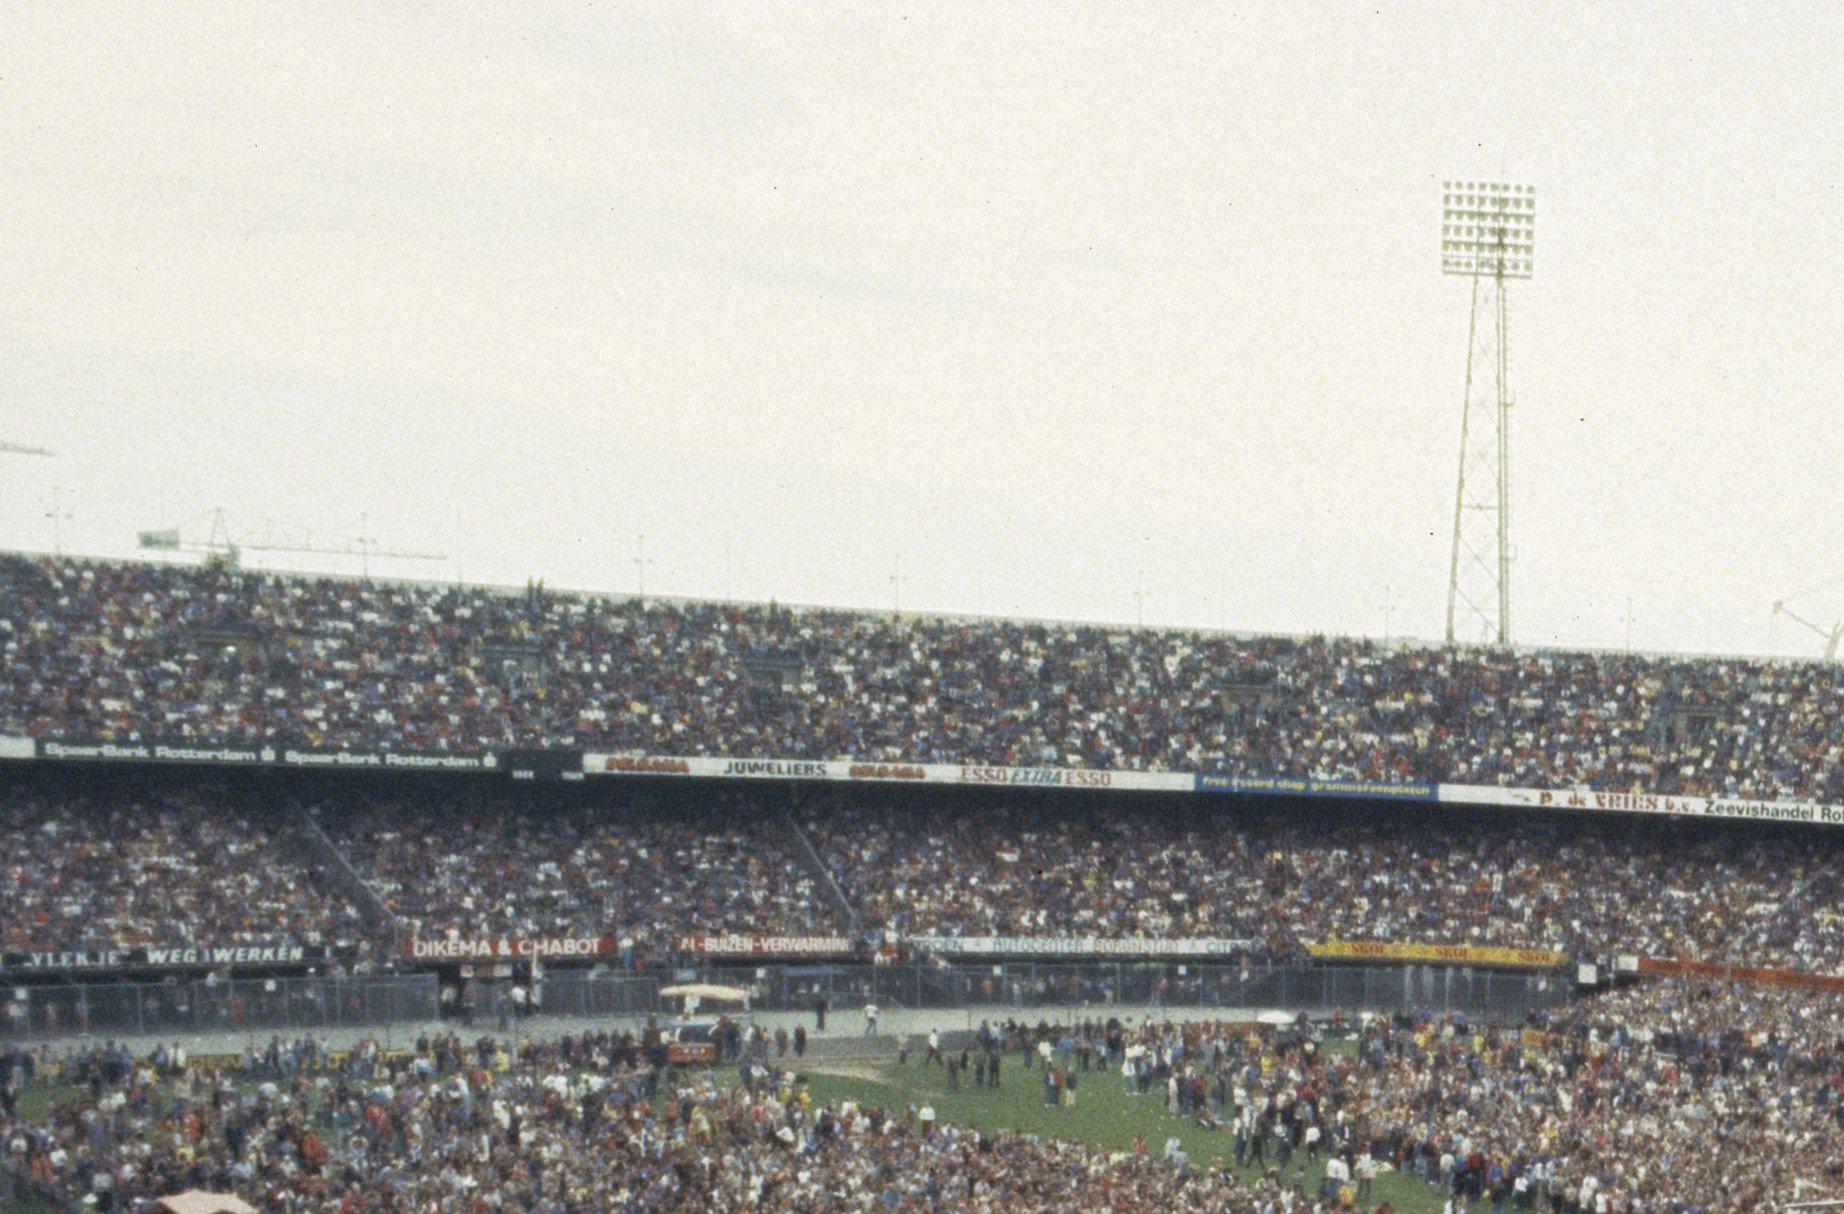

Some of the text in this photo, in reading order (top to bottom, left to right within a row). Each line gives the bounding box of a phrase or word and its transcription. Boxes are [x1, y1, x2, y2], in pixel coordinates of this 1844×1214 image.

[155, 745, 257, 761] Rotterdam
[386, 753, 480, 767] Rotterdam
[723, 760, 827, 776] JUWELIERS
[961, 767, 1008, 783] ESSO
[1065, 771, 1112, 787] ESSO
[1277, 779, 1306, 792] shop
[1568, 793, 1587, 806] de
[1595, 793, 1659, 811] VRIES
[1704, 799, 1815, 821] Zeevishandel
[213, 945, 304, 963] WERKEN
[413, 937, 602, 957] DIKEMA & CHABOT
